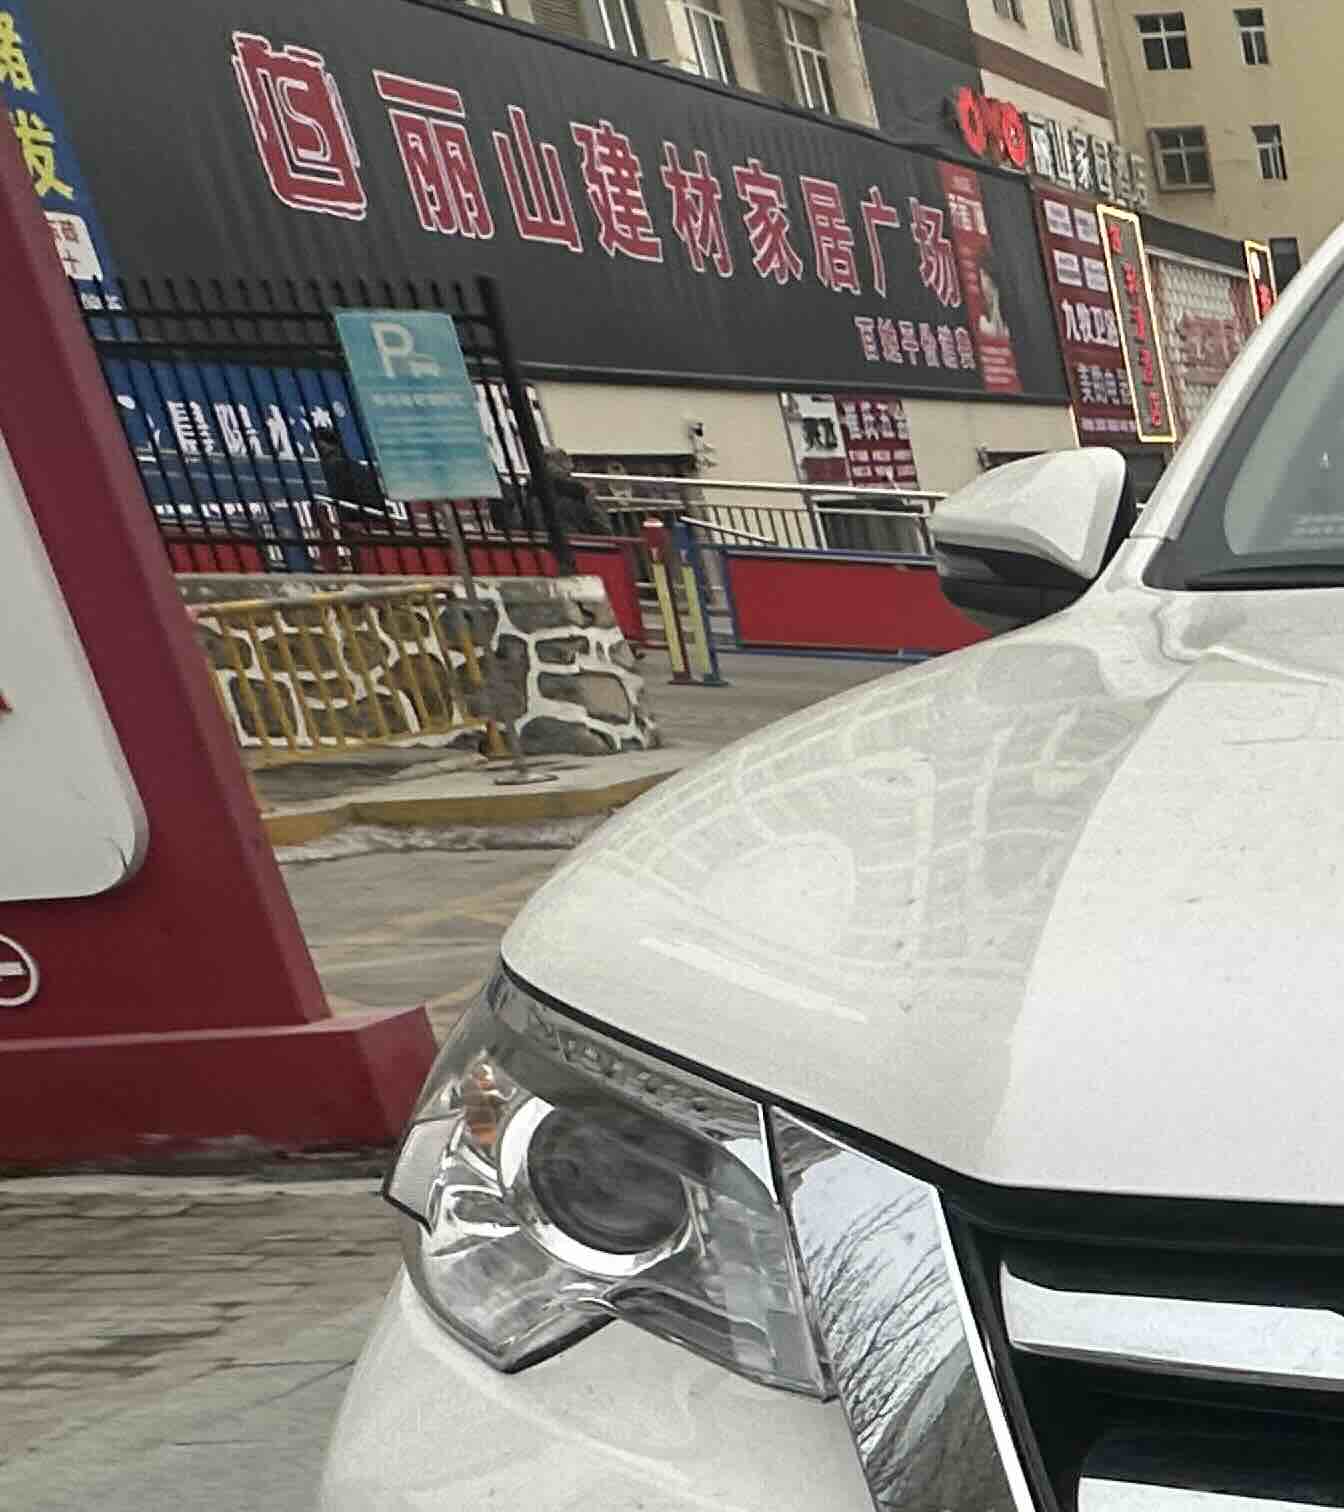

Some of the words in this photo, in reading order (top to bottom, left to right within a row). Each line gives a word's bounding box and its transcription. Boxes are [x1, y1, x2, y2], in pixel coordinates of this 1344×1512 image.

[373, 69, 962, 308] 丽山建材家居广场
